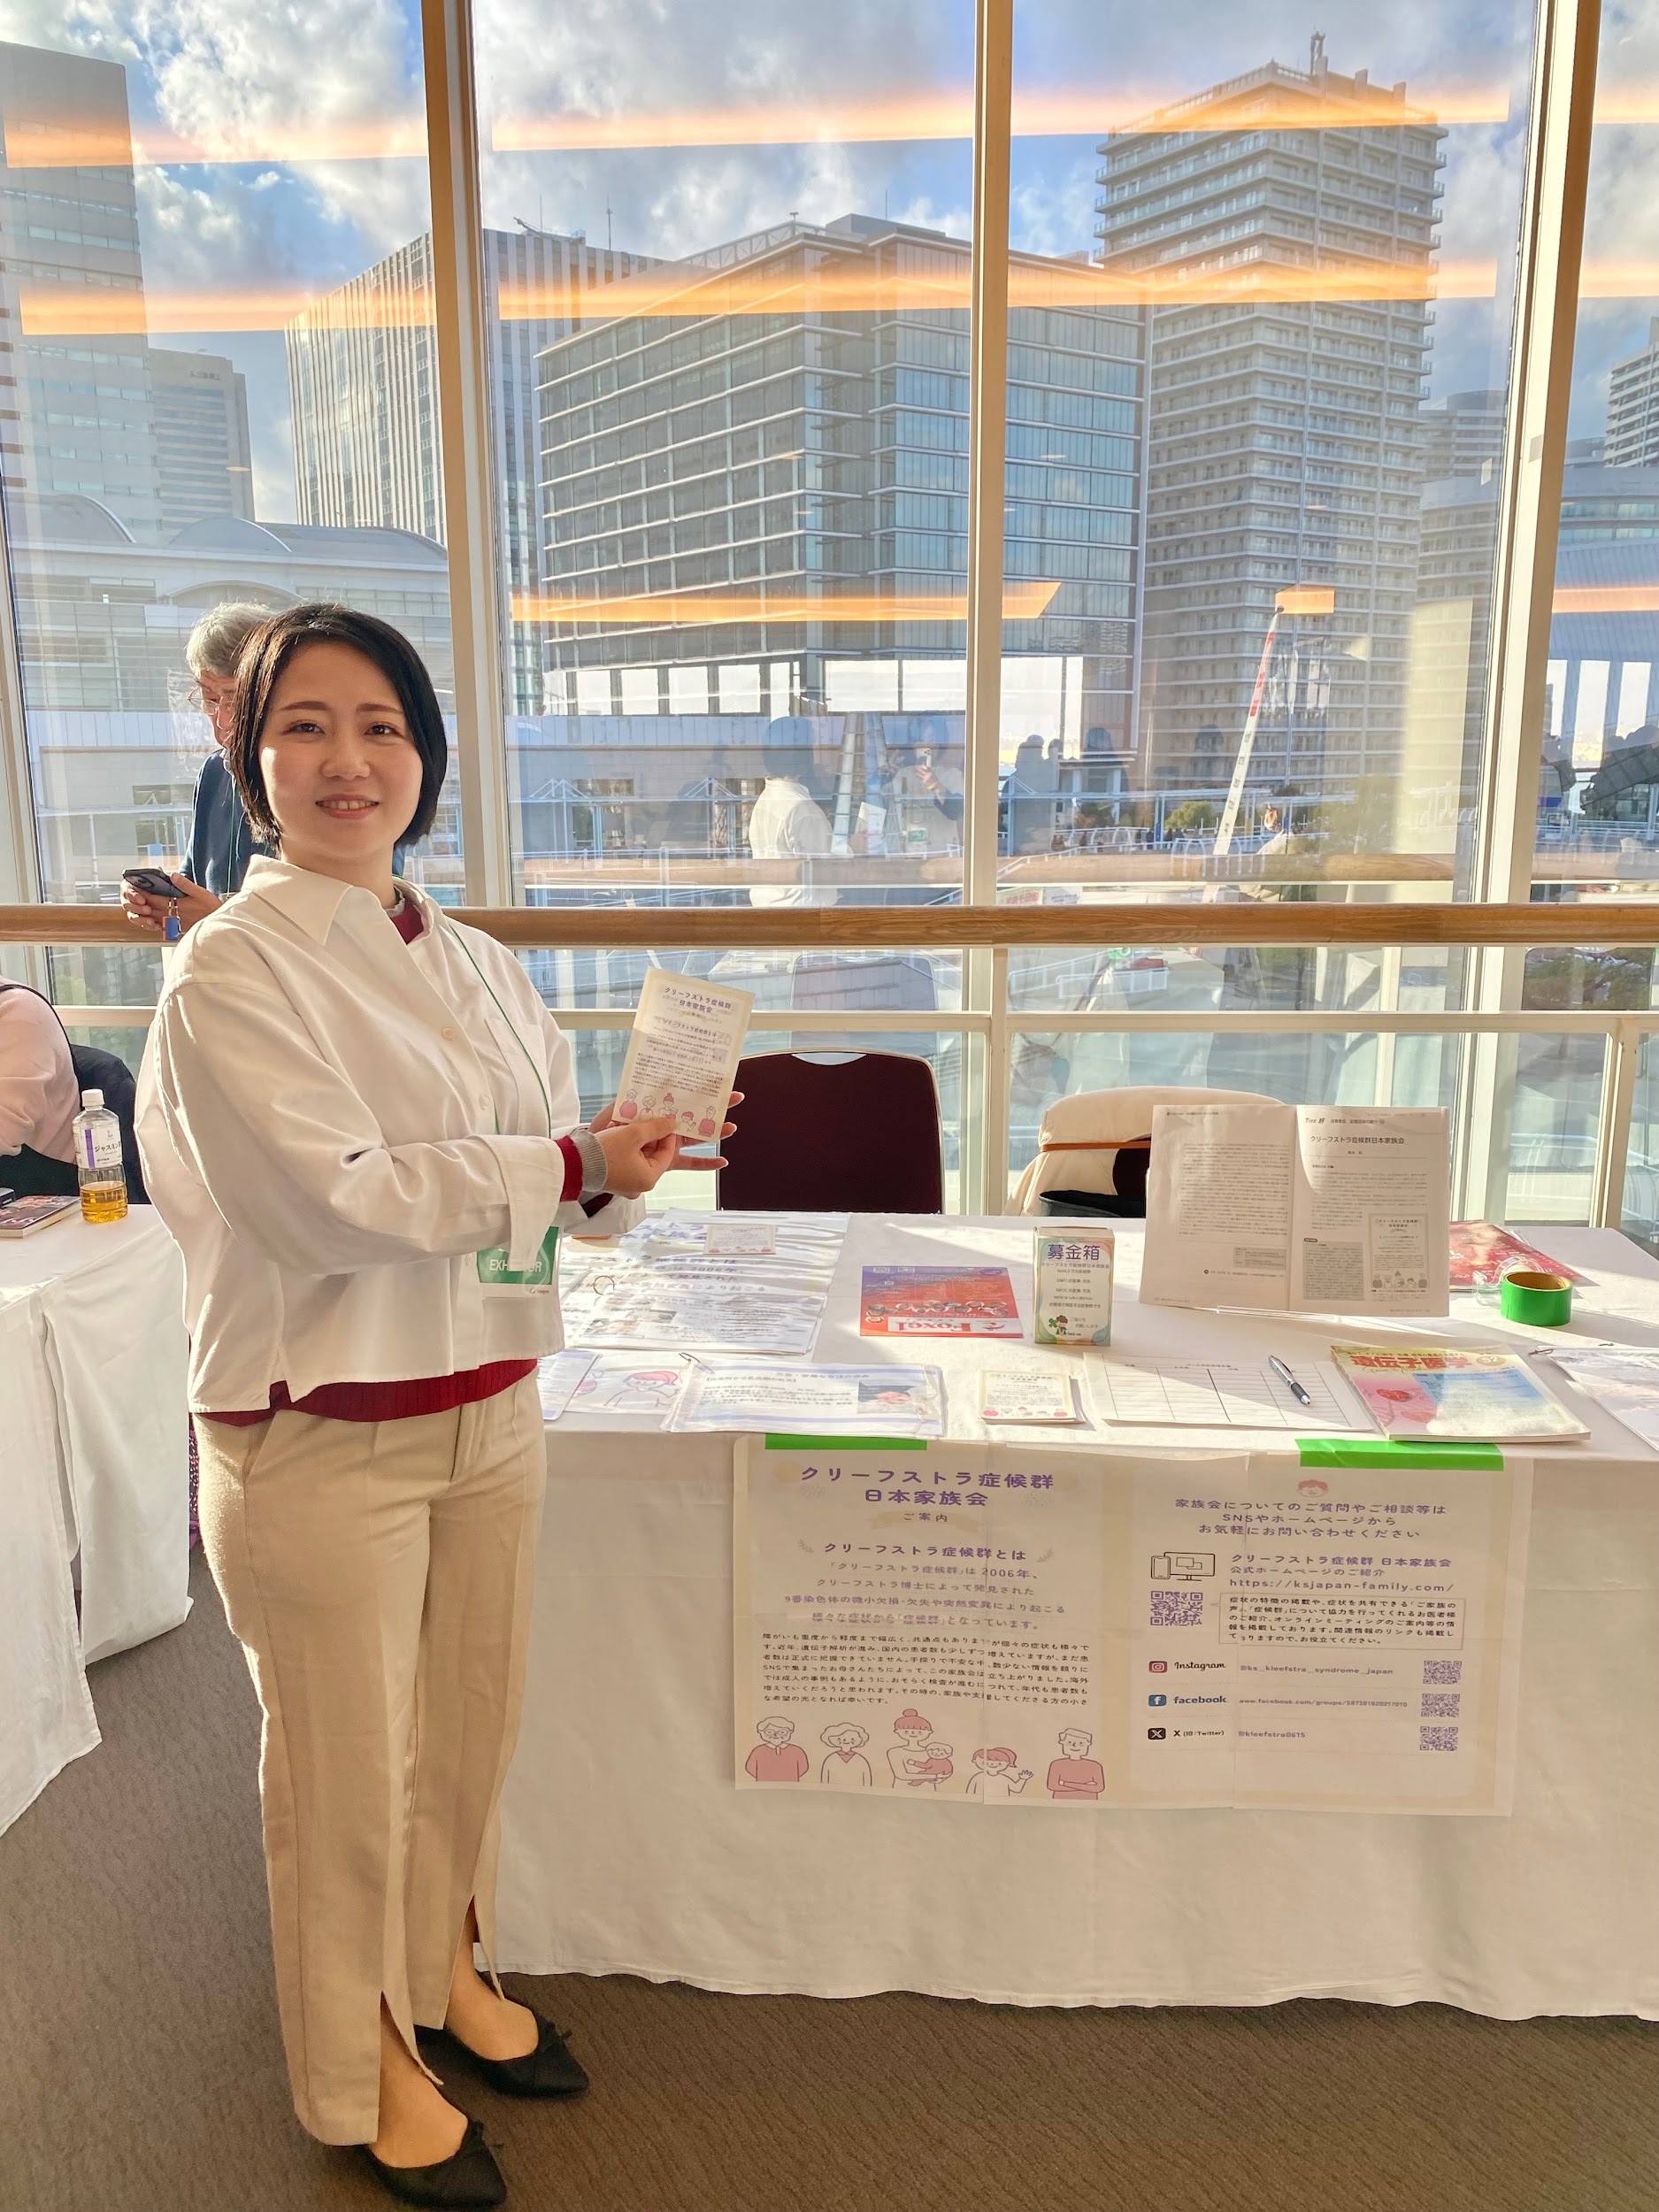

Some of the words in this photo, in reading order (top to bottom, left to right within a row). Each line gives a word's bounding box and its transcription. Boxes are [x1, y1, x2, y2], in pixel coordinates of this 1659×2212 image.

[1310, 1135, 1405, 1144] クリーフストラ症候群日本家族会
[1048, 1244, 1100, 1261] 募金箱
[802, 1467, 1054, 1489] クリーフストラ症候群
[864, 1489, 988, 1506] 日本家族会
[1175, 1499, 1447, 1514] 家族会についてのご質問やご相談等は
[903, 1512, 948, 1522] ご案内
[1223, 1514, 1395, 1526] SNSやホームページから
[1199, 1524, 1420, 1538] お気軽にお問い合わせください
[825, 1543, 1026, 1560] クリーフストラ症候群とは
[1232, 1555, 1373, 1566] クリーフストラ症候群
[1381, 1557, 1451, 1567] 日本家族会
[1231, 1566, 1385, 1577] 公式ホームページのご紹介
[817, 1578, 1033, 1595] クリーフストラ博士によって発見された
[1230, 1578, 1454, 1593] https://ksjapan-family.com/
[1174, 1661, 1225, 1671] Instagram
[1174, 1695, 1226, 1704] facebook
